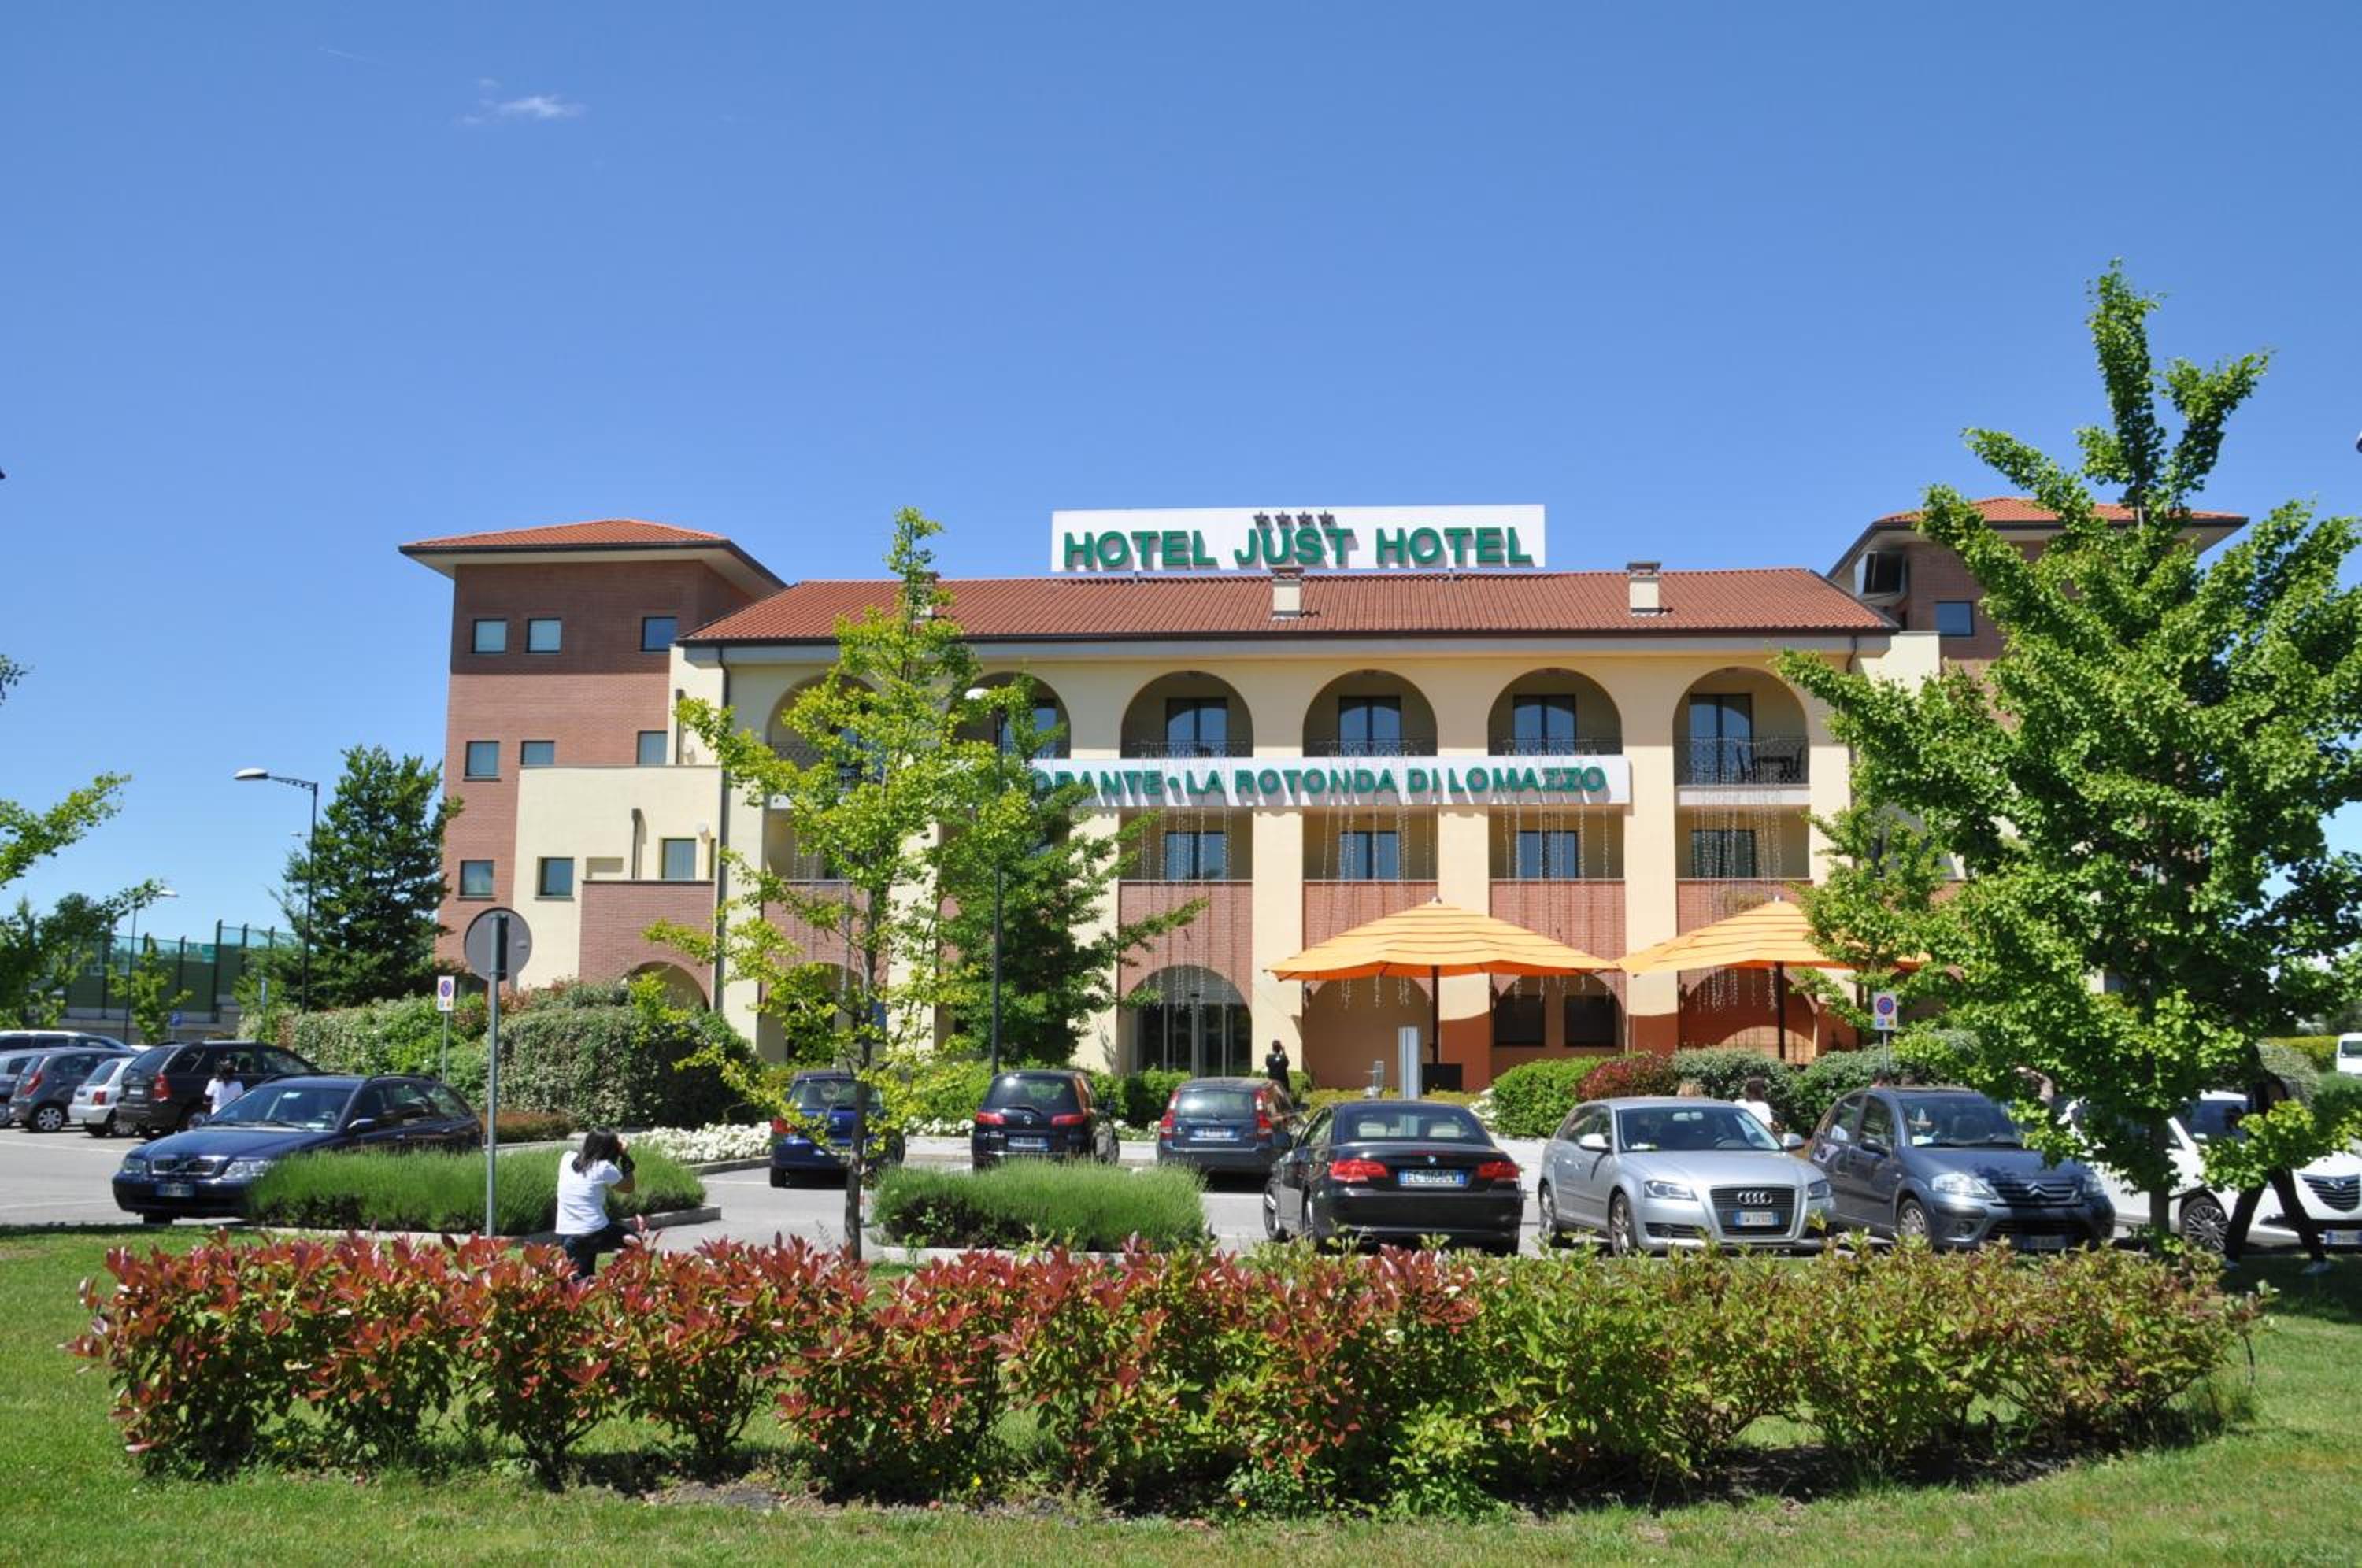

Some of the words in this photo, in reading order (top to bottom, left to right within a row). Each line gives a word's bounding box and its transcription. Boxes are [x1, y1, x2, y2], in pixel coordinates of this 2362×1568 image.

[1063, 530, 1217, 568] HOTEL
[1233, 527, 1354, 564] JUST
[1375, 527, 1533, 564] HOTEL
[1185, 769, 1225, 794] LA
[1234, 767, 1398, 794] ROTONDA
[1405, 767, 1439, 793] DI
[1448, 766, 1607, 792] LOMAZZO
